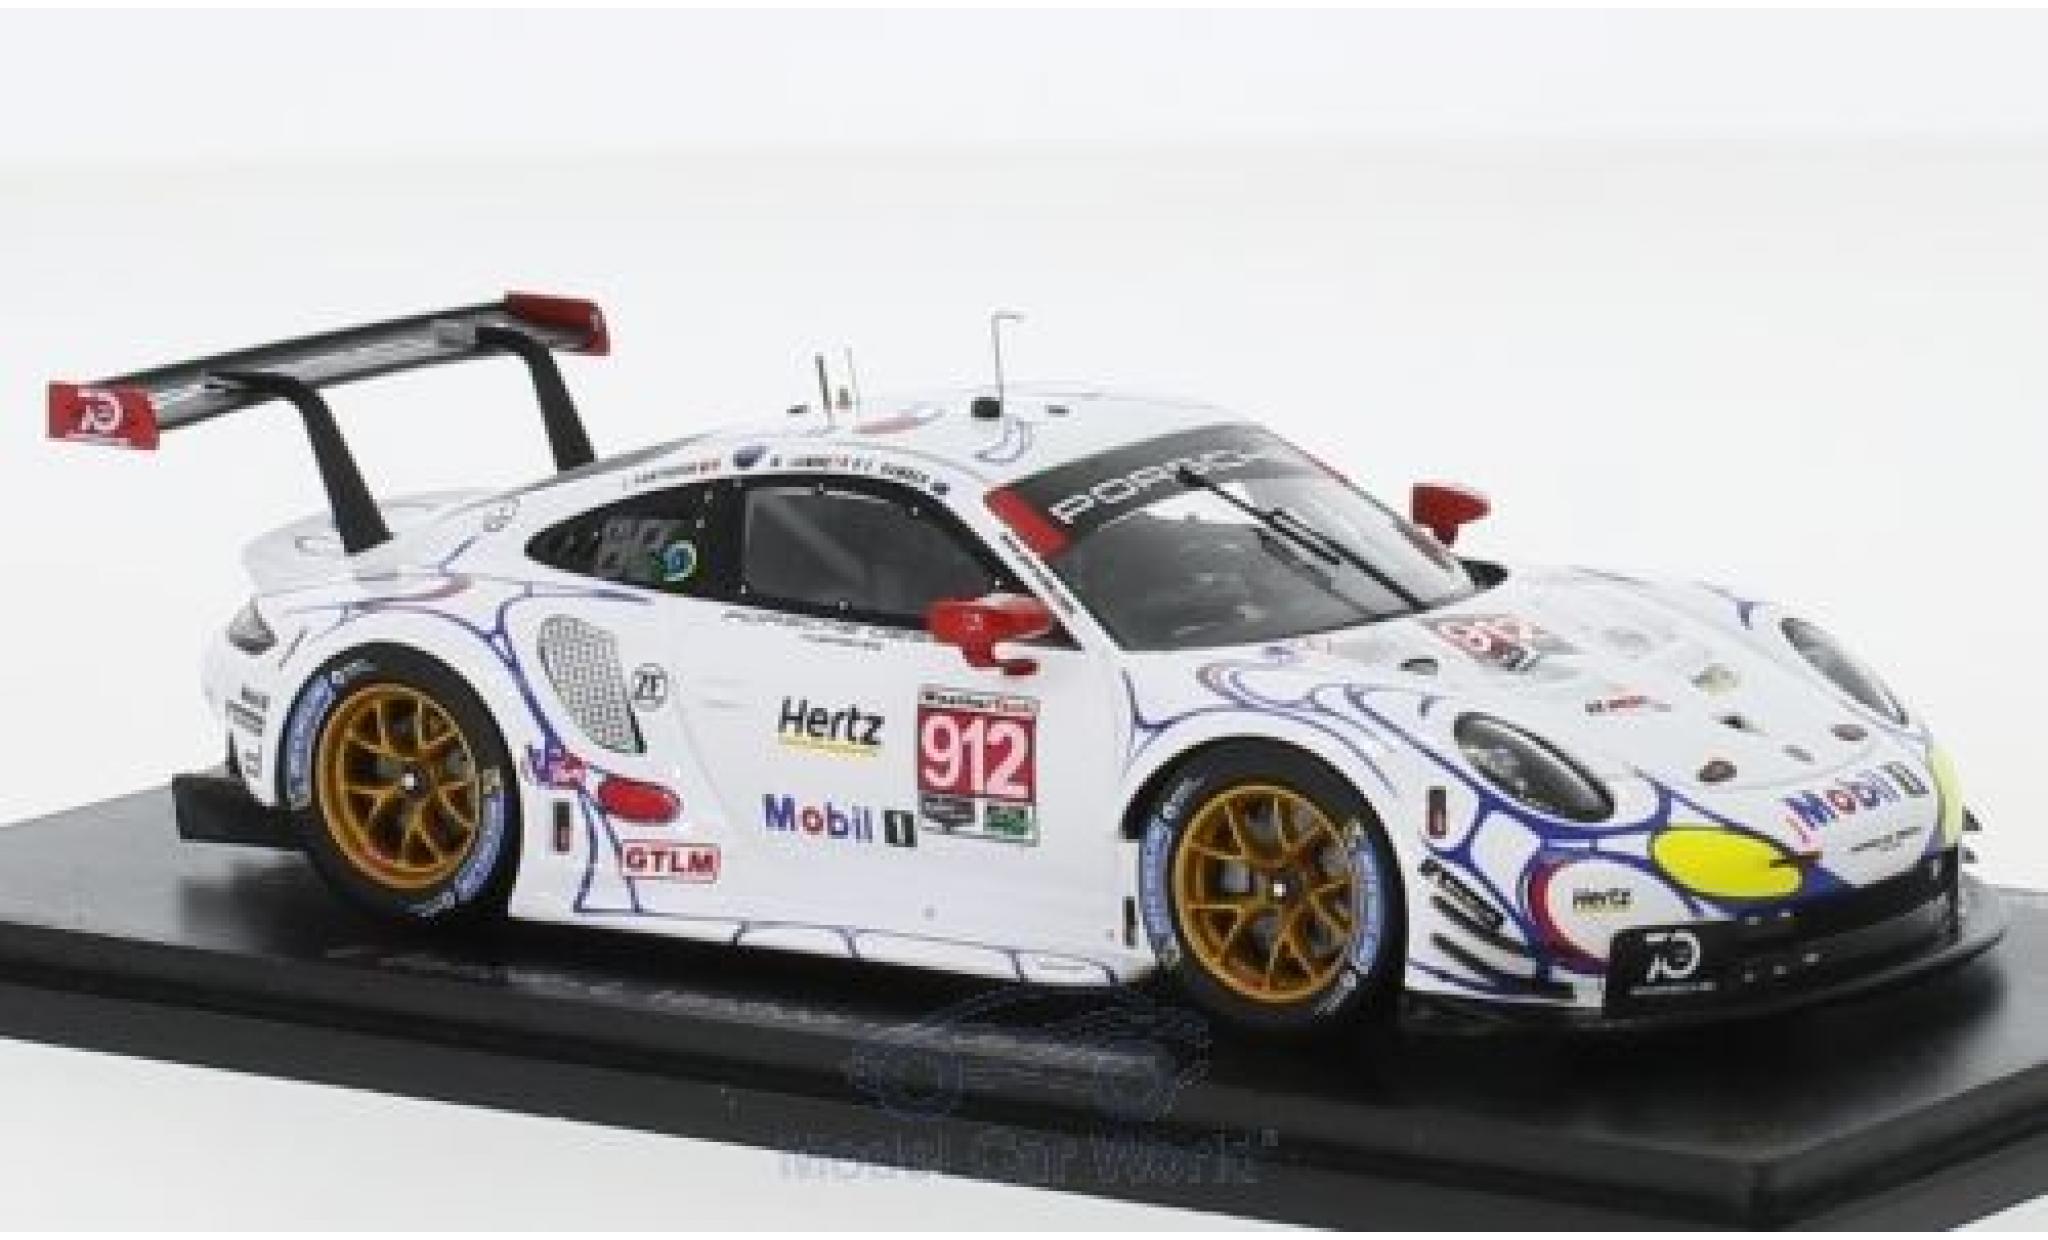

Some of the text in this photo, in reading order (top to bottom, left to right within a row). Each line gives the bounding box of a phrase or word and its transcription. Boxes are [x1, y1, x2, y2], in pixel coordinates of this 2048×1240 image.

[778, 696, 885, 746] Hertz
[924, 714, 1028, 797] 912
[762, 794, 873, 843] Mobil
[1785, 769, 1900, 831] Mobil
[626, 846, 714, 873] GTLM
[1573, 888, 1631, 911] Hertz
